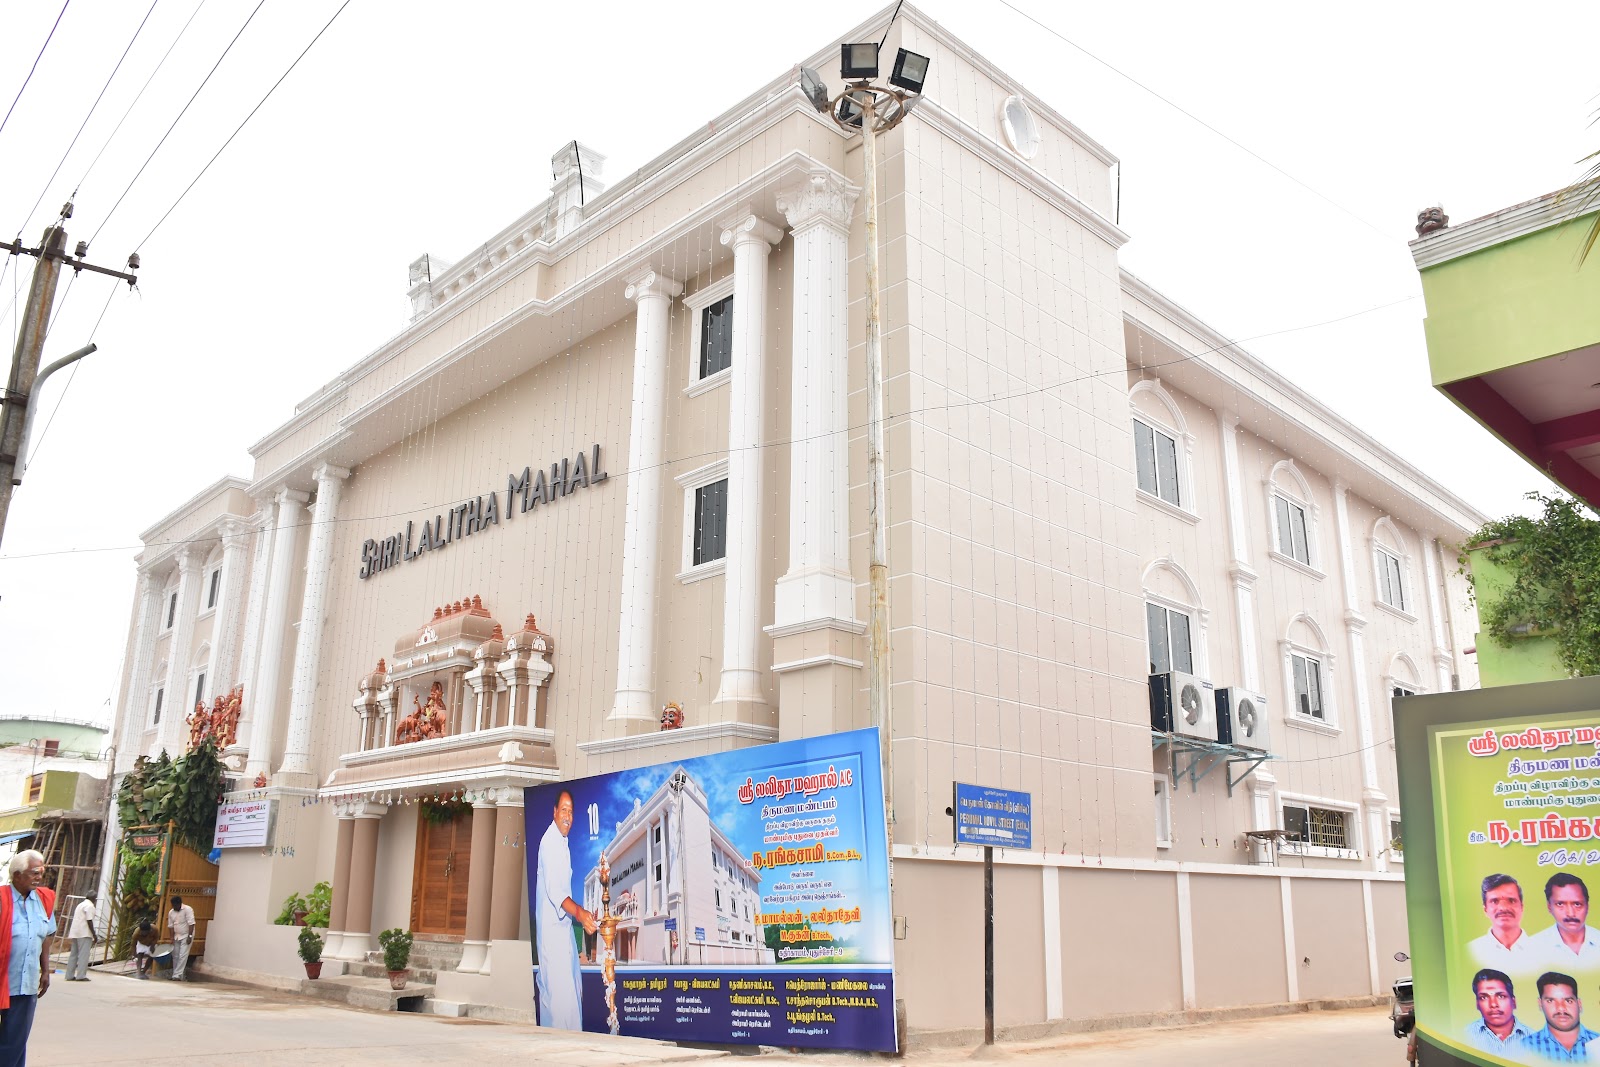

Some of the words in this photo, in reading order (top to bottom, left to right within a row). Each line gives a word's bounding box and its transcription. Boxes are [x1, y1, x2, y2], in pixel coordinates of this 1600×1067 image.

[404, 491, 499, 562] LALITHA
[506, 444, 608, 519] MAHAL
[1468, 730, 1498, 755] ஸ்ரீ
[1501, 728, 1571, 751] லலிதா
[1509, 759, 1570, 775] திருமண
[738, 778, 754, 803] ஸ்ரீ
[756, 775, 791, 799] லலிதா
[794, 766, 837, 796] மஹால்
[1495, 781, 1527, 793] திறப்பு
[1530, 777, 1589, 791] விழாவிற்கு
[762, 805, 794, 818] திருமண
[797, 797, 837, 812] மண்டபம்
[1505, 795, 1564, 807] மாண்புமிகு
[587, 802, 600, 835] 10
[998, 817, 1015, 829] STREET
[1489, 813, 1600, 845] ந.ரங்க
[752, 844, 825, 868] ந.ரங்கசாமி
[810, 906, 861, 924] லலிதாதேவி
